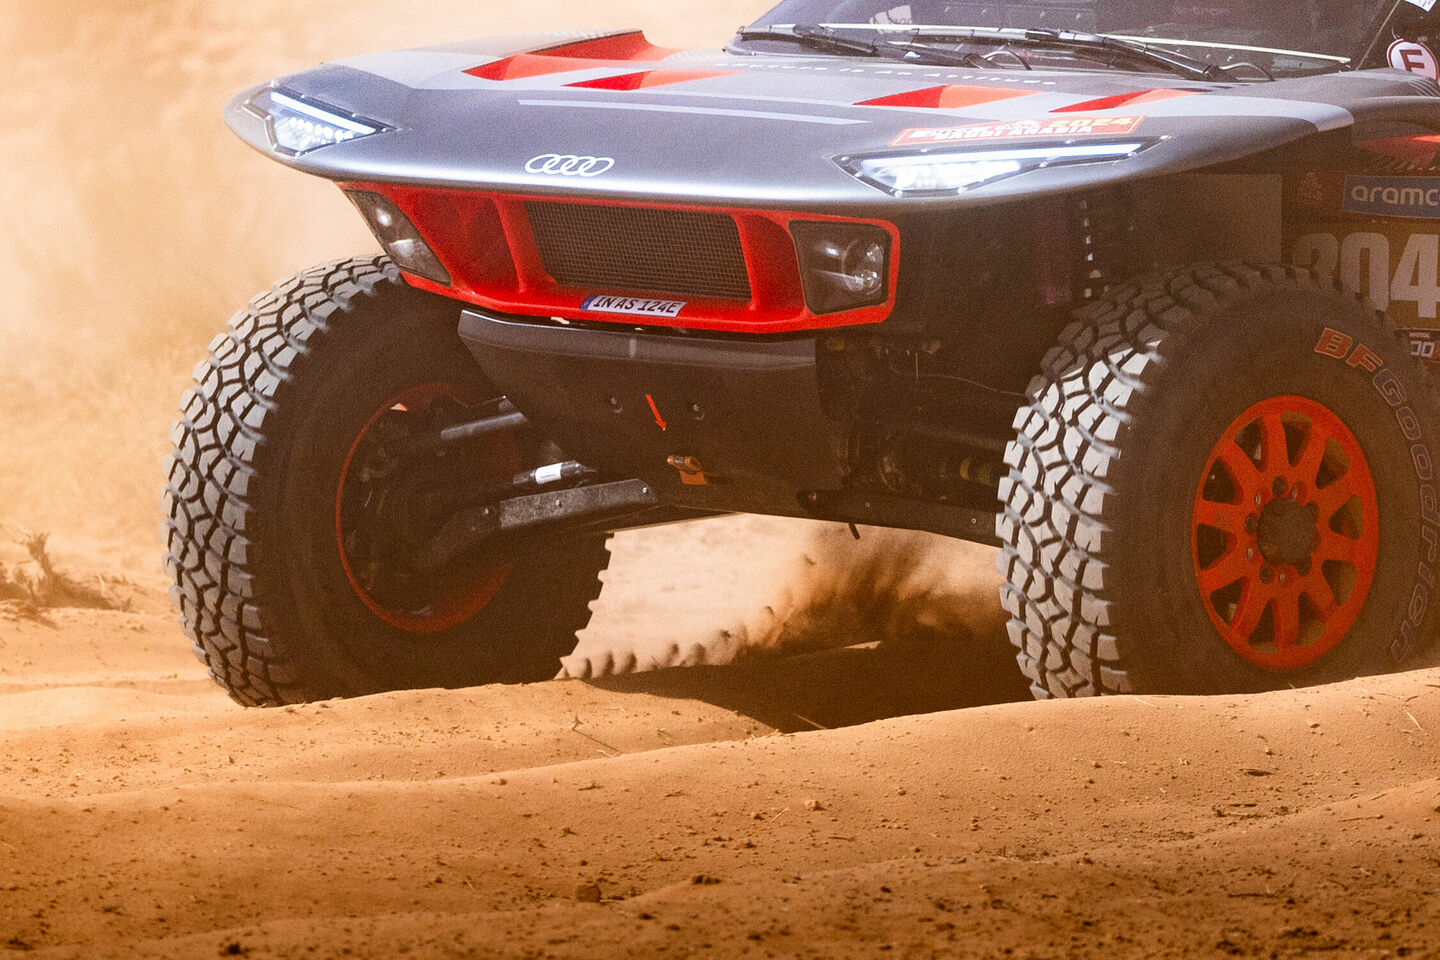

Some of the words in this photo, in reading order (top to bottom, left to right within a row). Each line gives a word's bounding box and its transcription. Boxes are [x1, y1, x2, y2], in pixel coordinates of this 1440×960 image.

[1049, 117, 1134, 129] 2024
[1007, 125, 1093, 136] ARABIA
[593, 296, 617, 309] IN
[614, 298, 638, 310] AS
[638, 300, 681, 313] 124E
